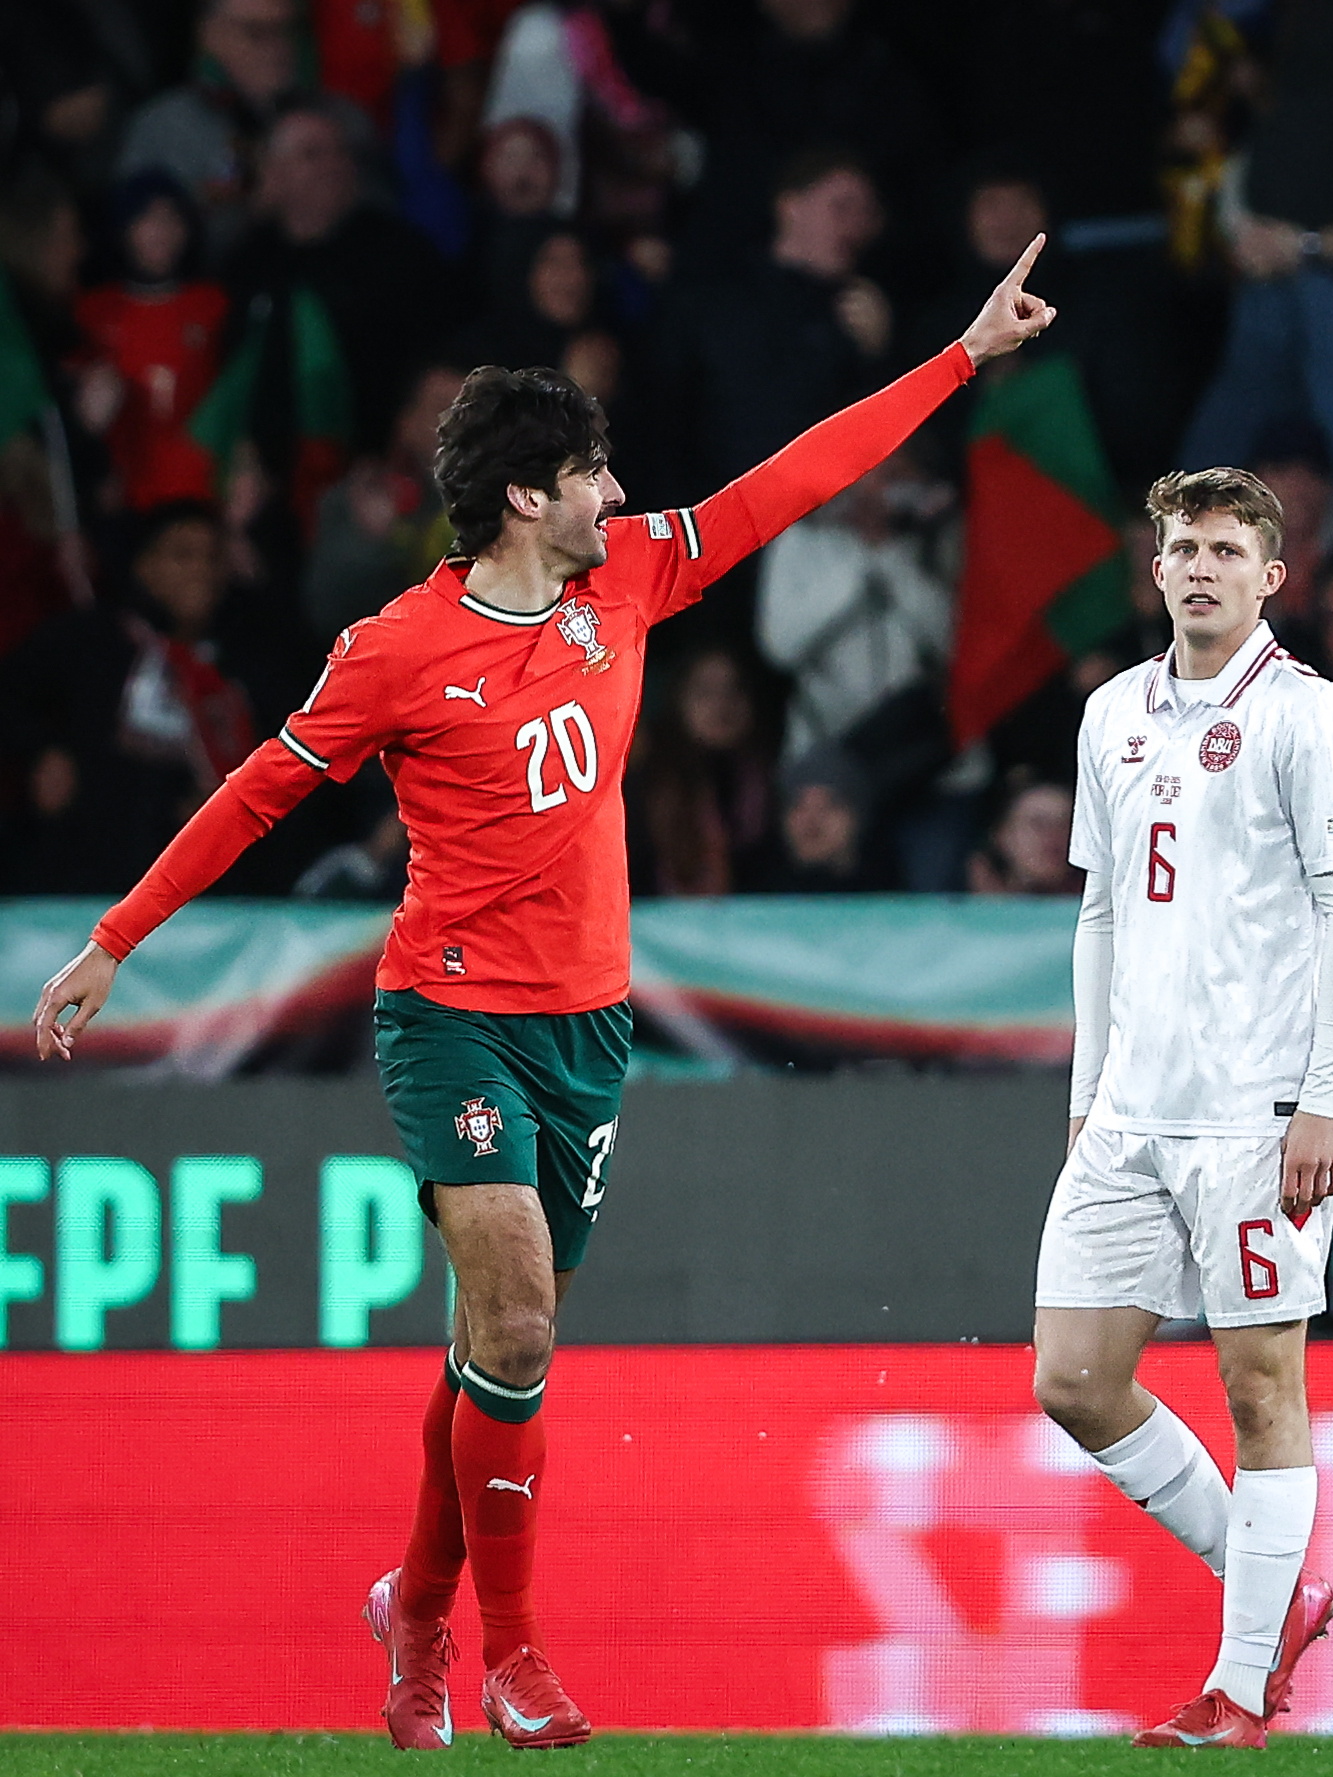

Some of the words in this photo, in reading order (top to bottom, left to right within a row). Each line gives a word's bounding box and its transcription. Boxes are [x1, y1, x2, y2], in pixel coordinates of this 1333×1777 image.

[516, 700, 599, 814] 20
[1206, 736, 1234, 754] DBU
[1147, 822, 1176, 902] 6
[581, 1113, 619, 1208] 2
[1238, 1218, 1279, 1300] 6
